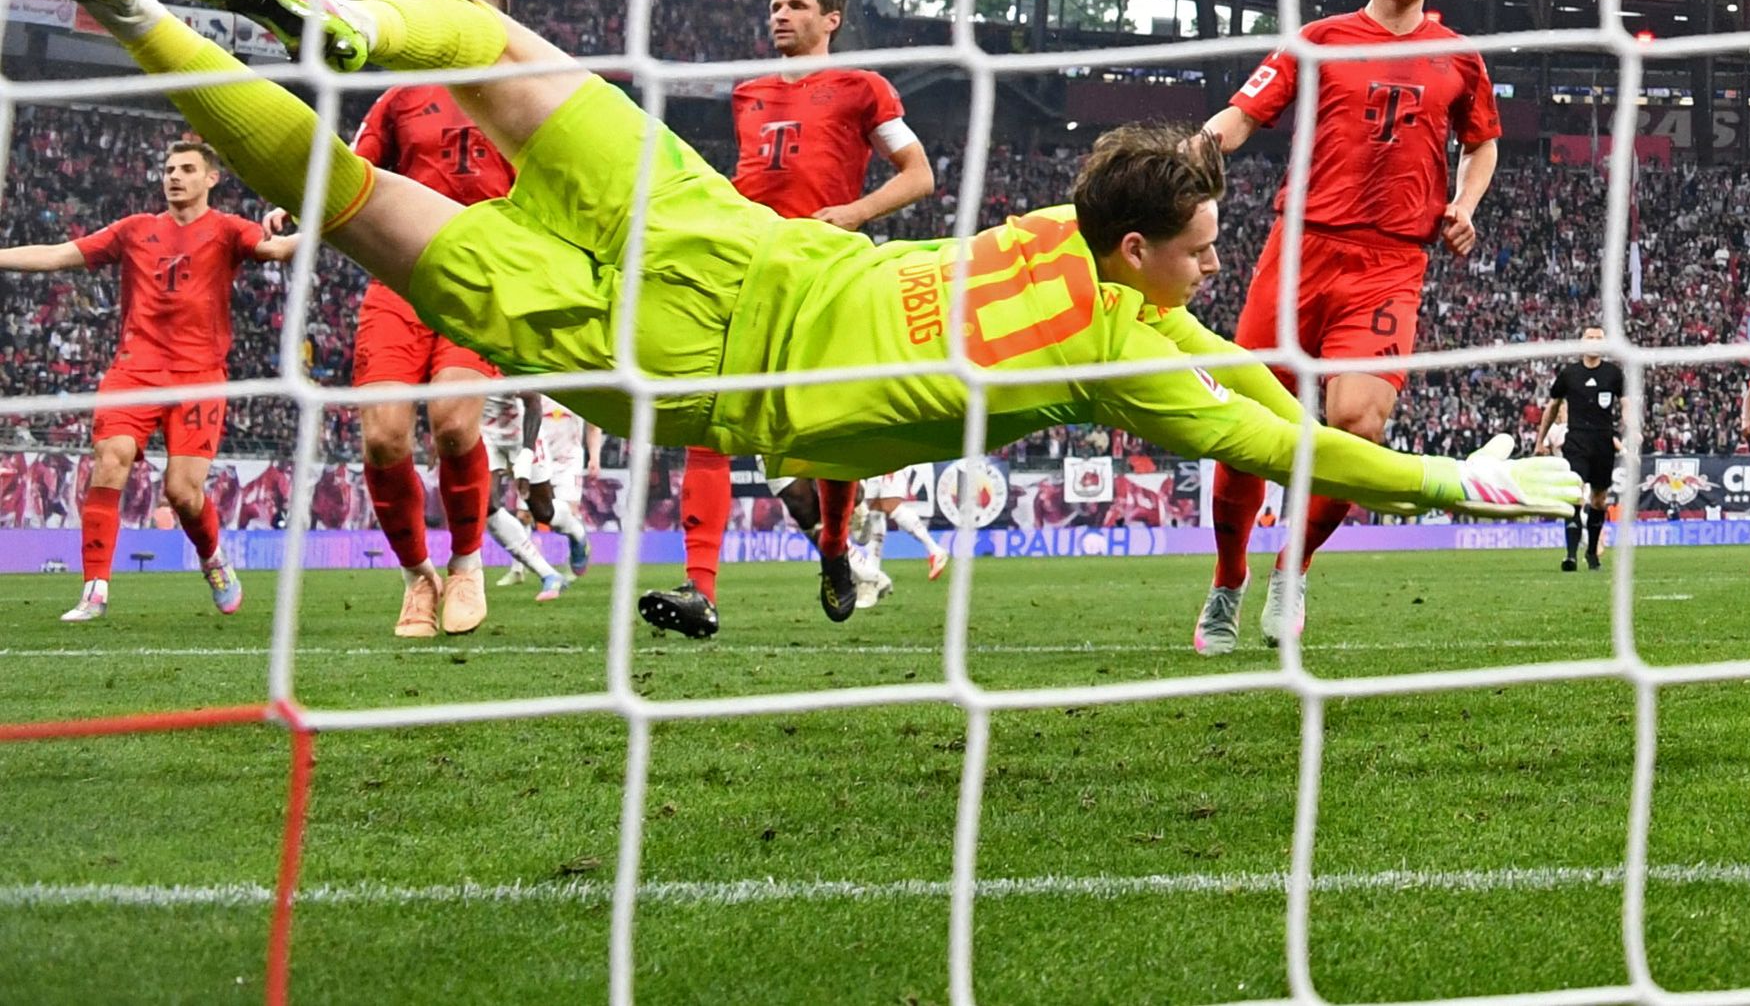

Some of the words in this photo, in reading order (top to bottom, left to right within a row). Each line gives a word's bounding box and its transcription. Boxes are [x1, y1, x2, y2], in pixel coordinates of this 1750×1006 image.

[898, 262, 943, 345] URBIG
[1371, 299, 1397, 336] 6
[1006, 526, 1130, 557] RAUCH
